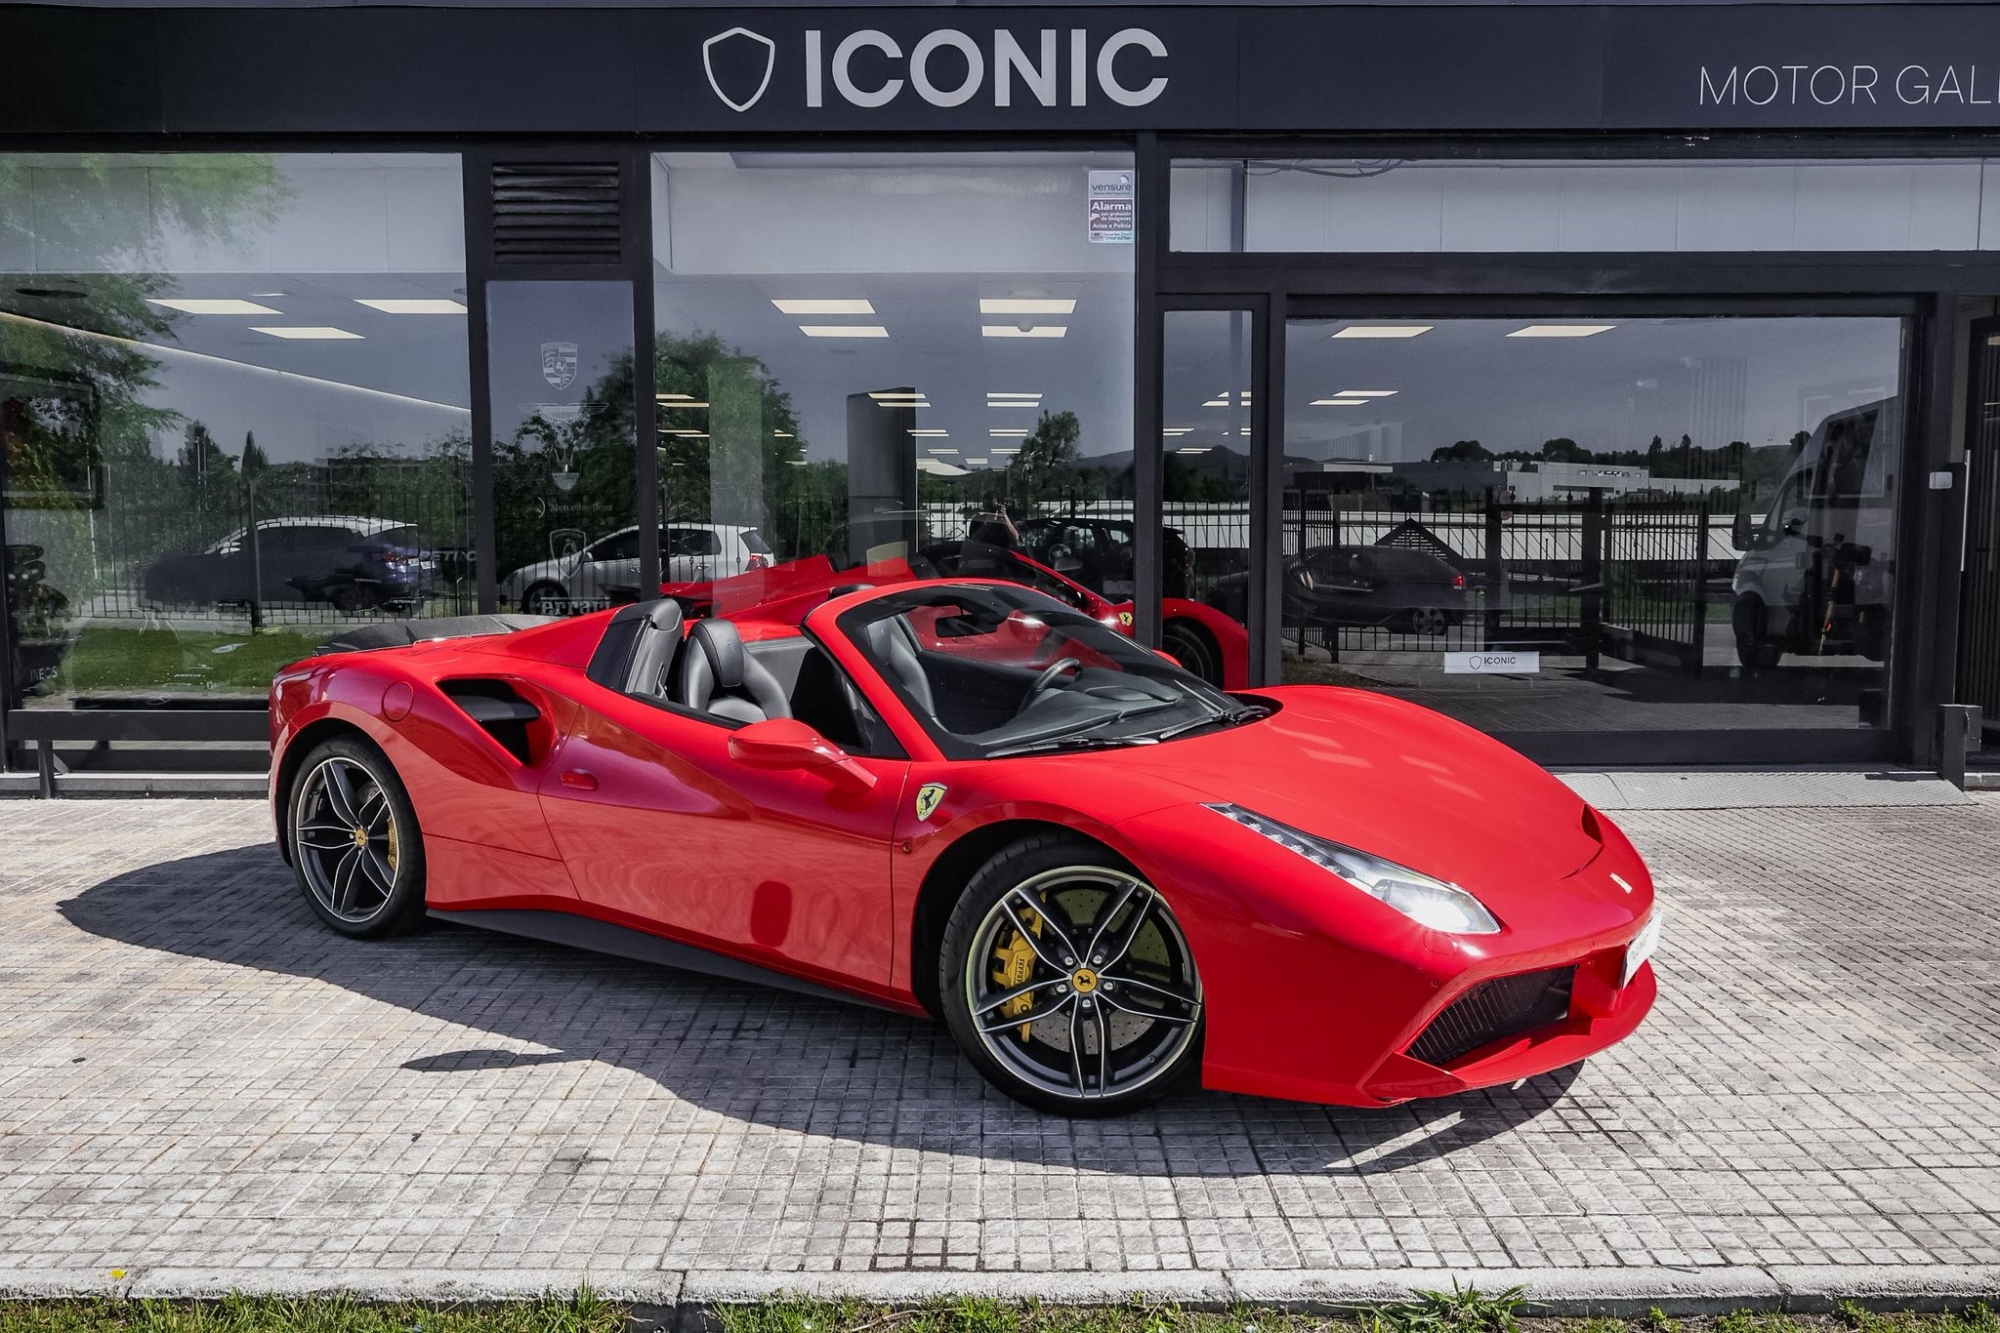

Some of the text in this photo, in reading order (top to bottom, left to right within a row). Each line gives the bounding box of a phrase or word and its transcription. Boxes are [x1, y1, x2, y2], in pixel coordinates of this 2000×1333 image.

[805, 28, 1169, 108] ICONIC
[1699, 65, 2000, 105] MOTOR GAL
[1092, 202, 1132, 210] Alarma
[540, 596, 611, 616] errari
[1484, 656, 1516, 664] ICONIC
[30, 665, 58, 682] INEOS
